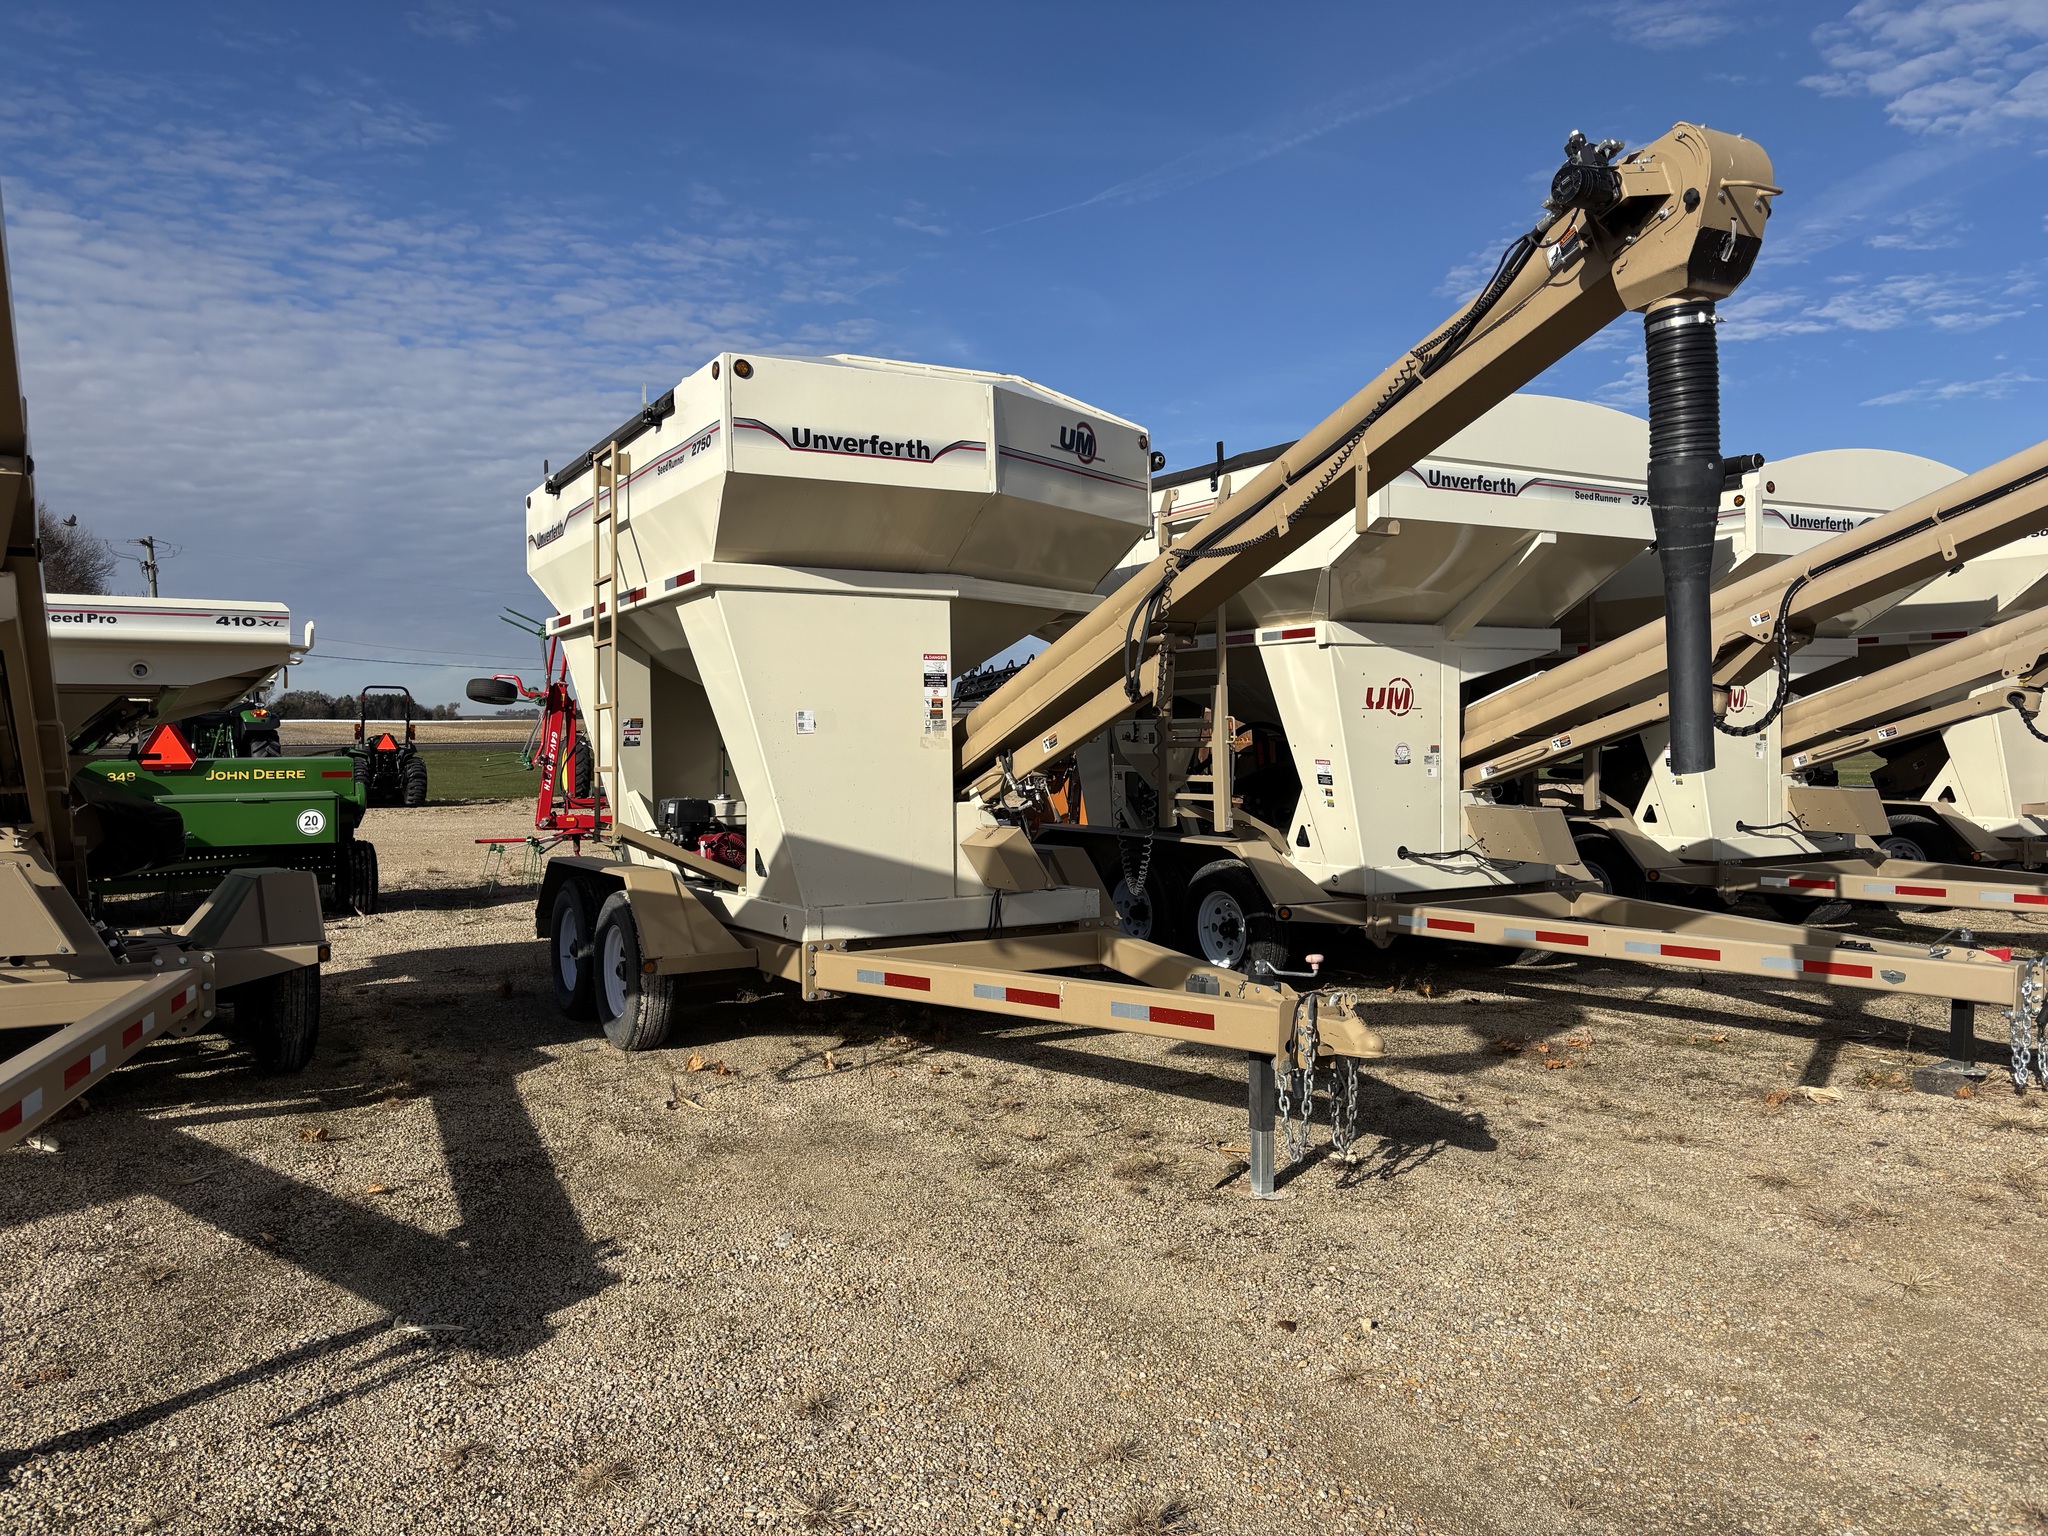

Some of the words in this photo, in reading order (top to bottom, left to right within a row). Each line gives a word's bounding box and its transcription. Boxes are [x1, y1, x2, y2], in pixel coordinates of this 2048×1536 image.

[791, 427, 931, 459] Unverferth
[1060, 425, 1094, 456] UM
[657, 461, 669, 476] Seed
[669, 455, 685, 470] Runner
[691, 434, 712, 457] 2750
[1428, 469, 1516, 494] Unverferth
[1574, 490, 1594, 501] Seed
[1594, 493, 1622, 504] Runner
[1790, 513, 1854, 531] Unverferth
[86, 613, 117, 624] Pro
[215, 616, 257, 627] 410
[258, 620, 286, 628] XL
[1365, 687, 1411, 709] UM
[106, 771, 137, 783] 348
[205, 769, 250, 781] JOHN
[253, 768, 306, 780] DEERE
[304, 815, 319, 827] 20
